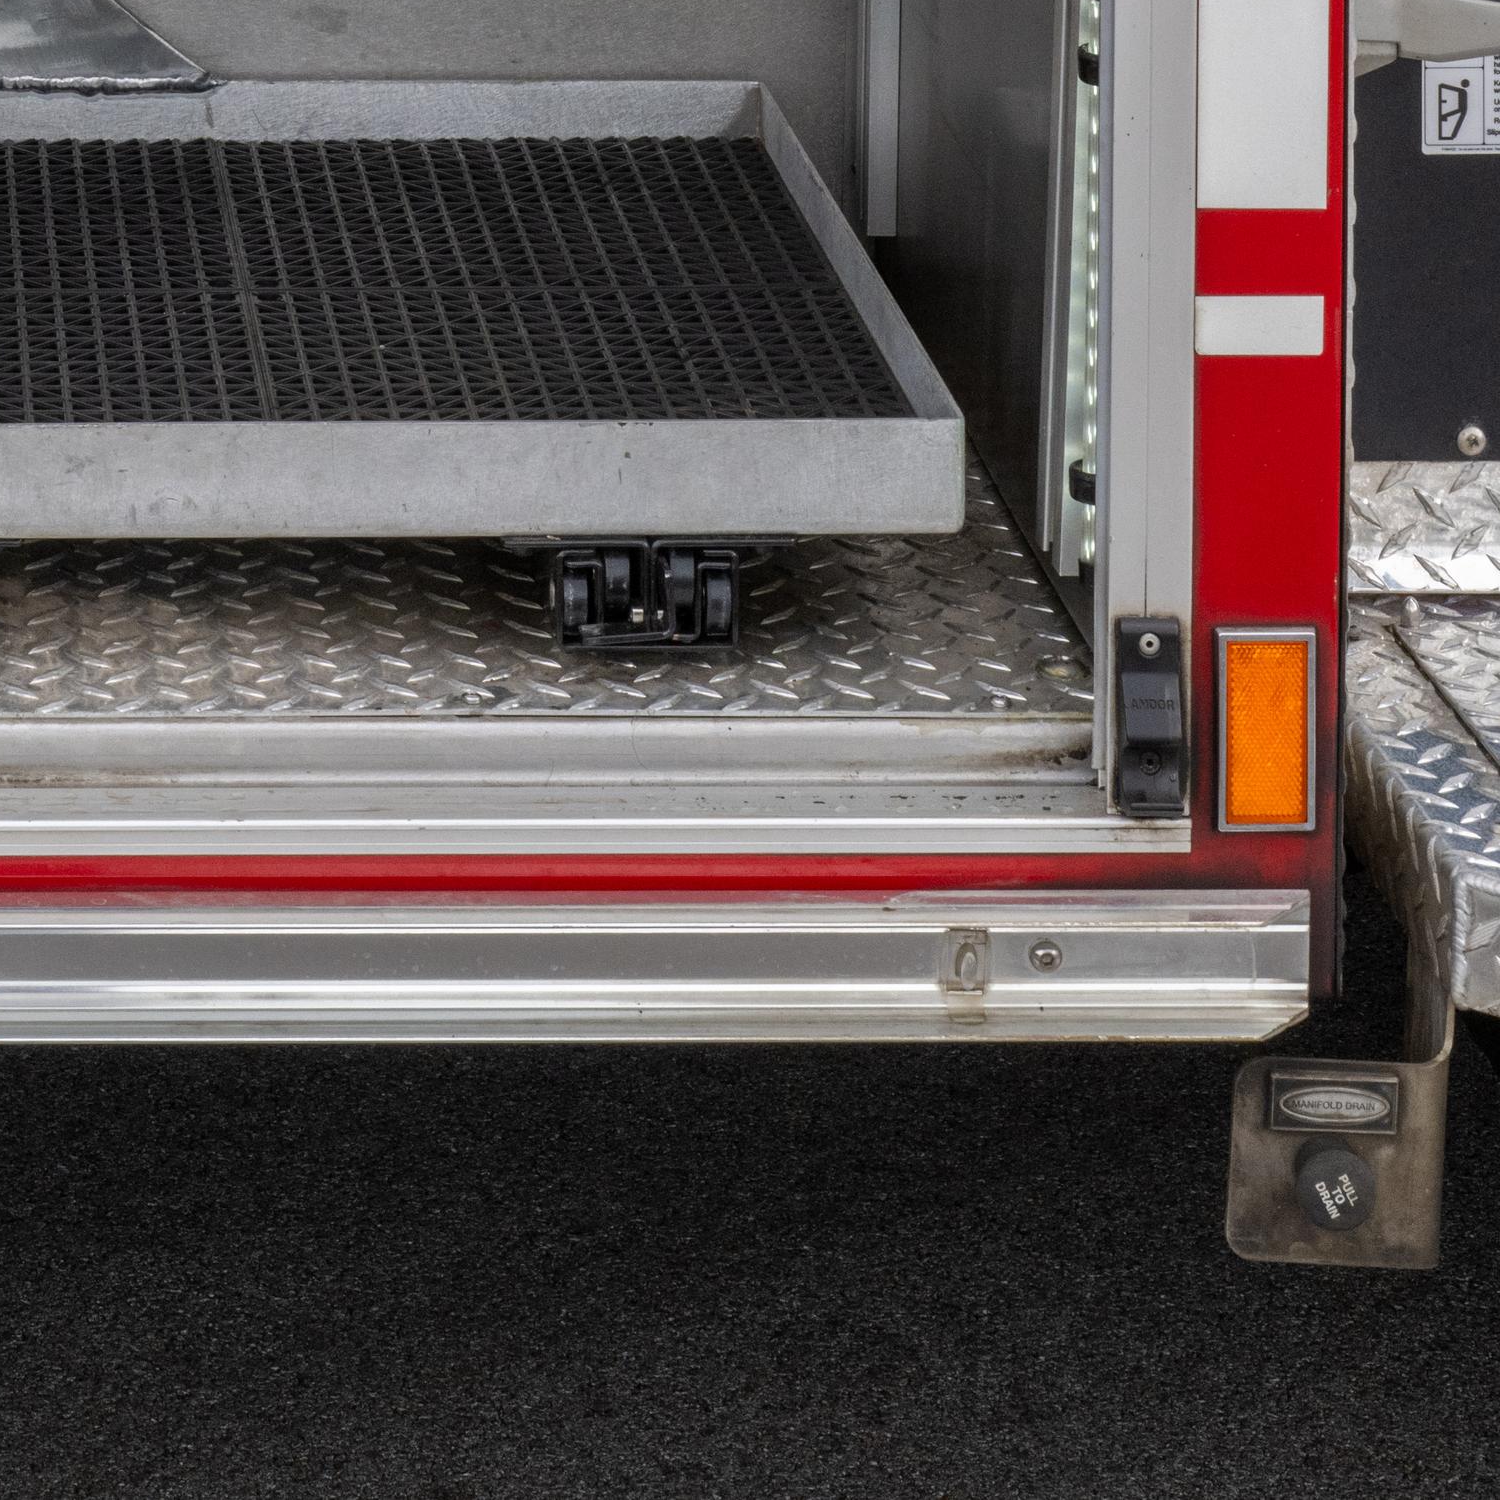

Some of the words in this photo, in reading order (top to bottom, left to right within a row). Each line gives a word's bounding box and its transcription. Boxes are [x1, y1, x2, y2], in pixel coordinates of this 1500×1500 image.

[1131, 698, 1175, 711] AMDOR
[1292, 1100, 1343, 1110] MANIFOLD
[1345, 1101, 1376, 1111] DRAIN
[1332, 1186, 1345, 1205] TO
[1338, 1174, 1359, 1207] PULL
[1315, 1181, 1341, 1220] DRAIN
